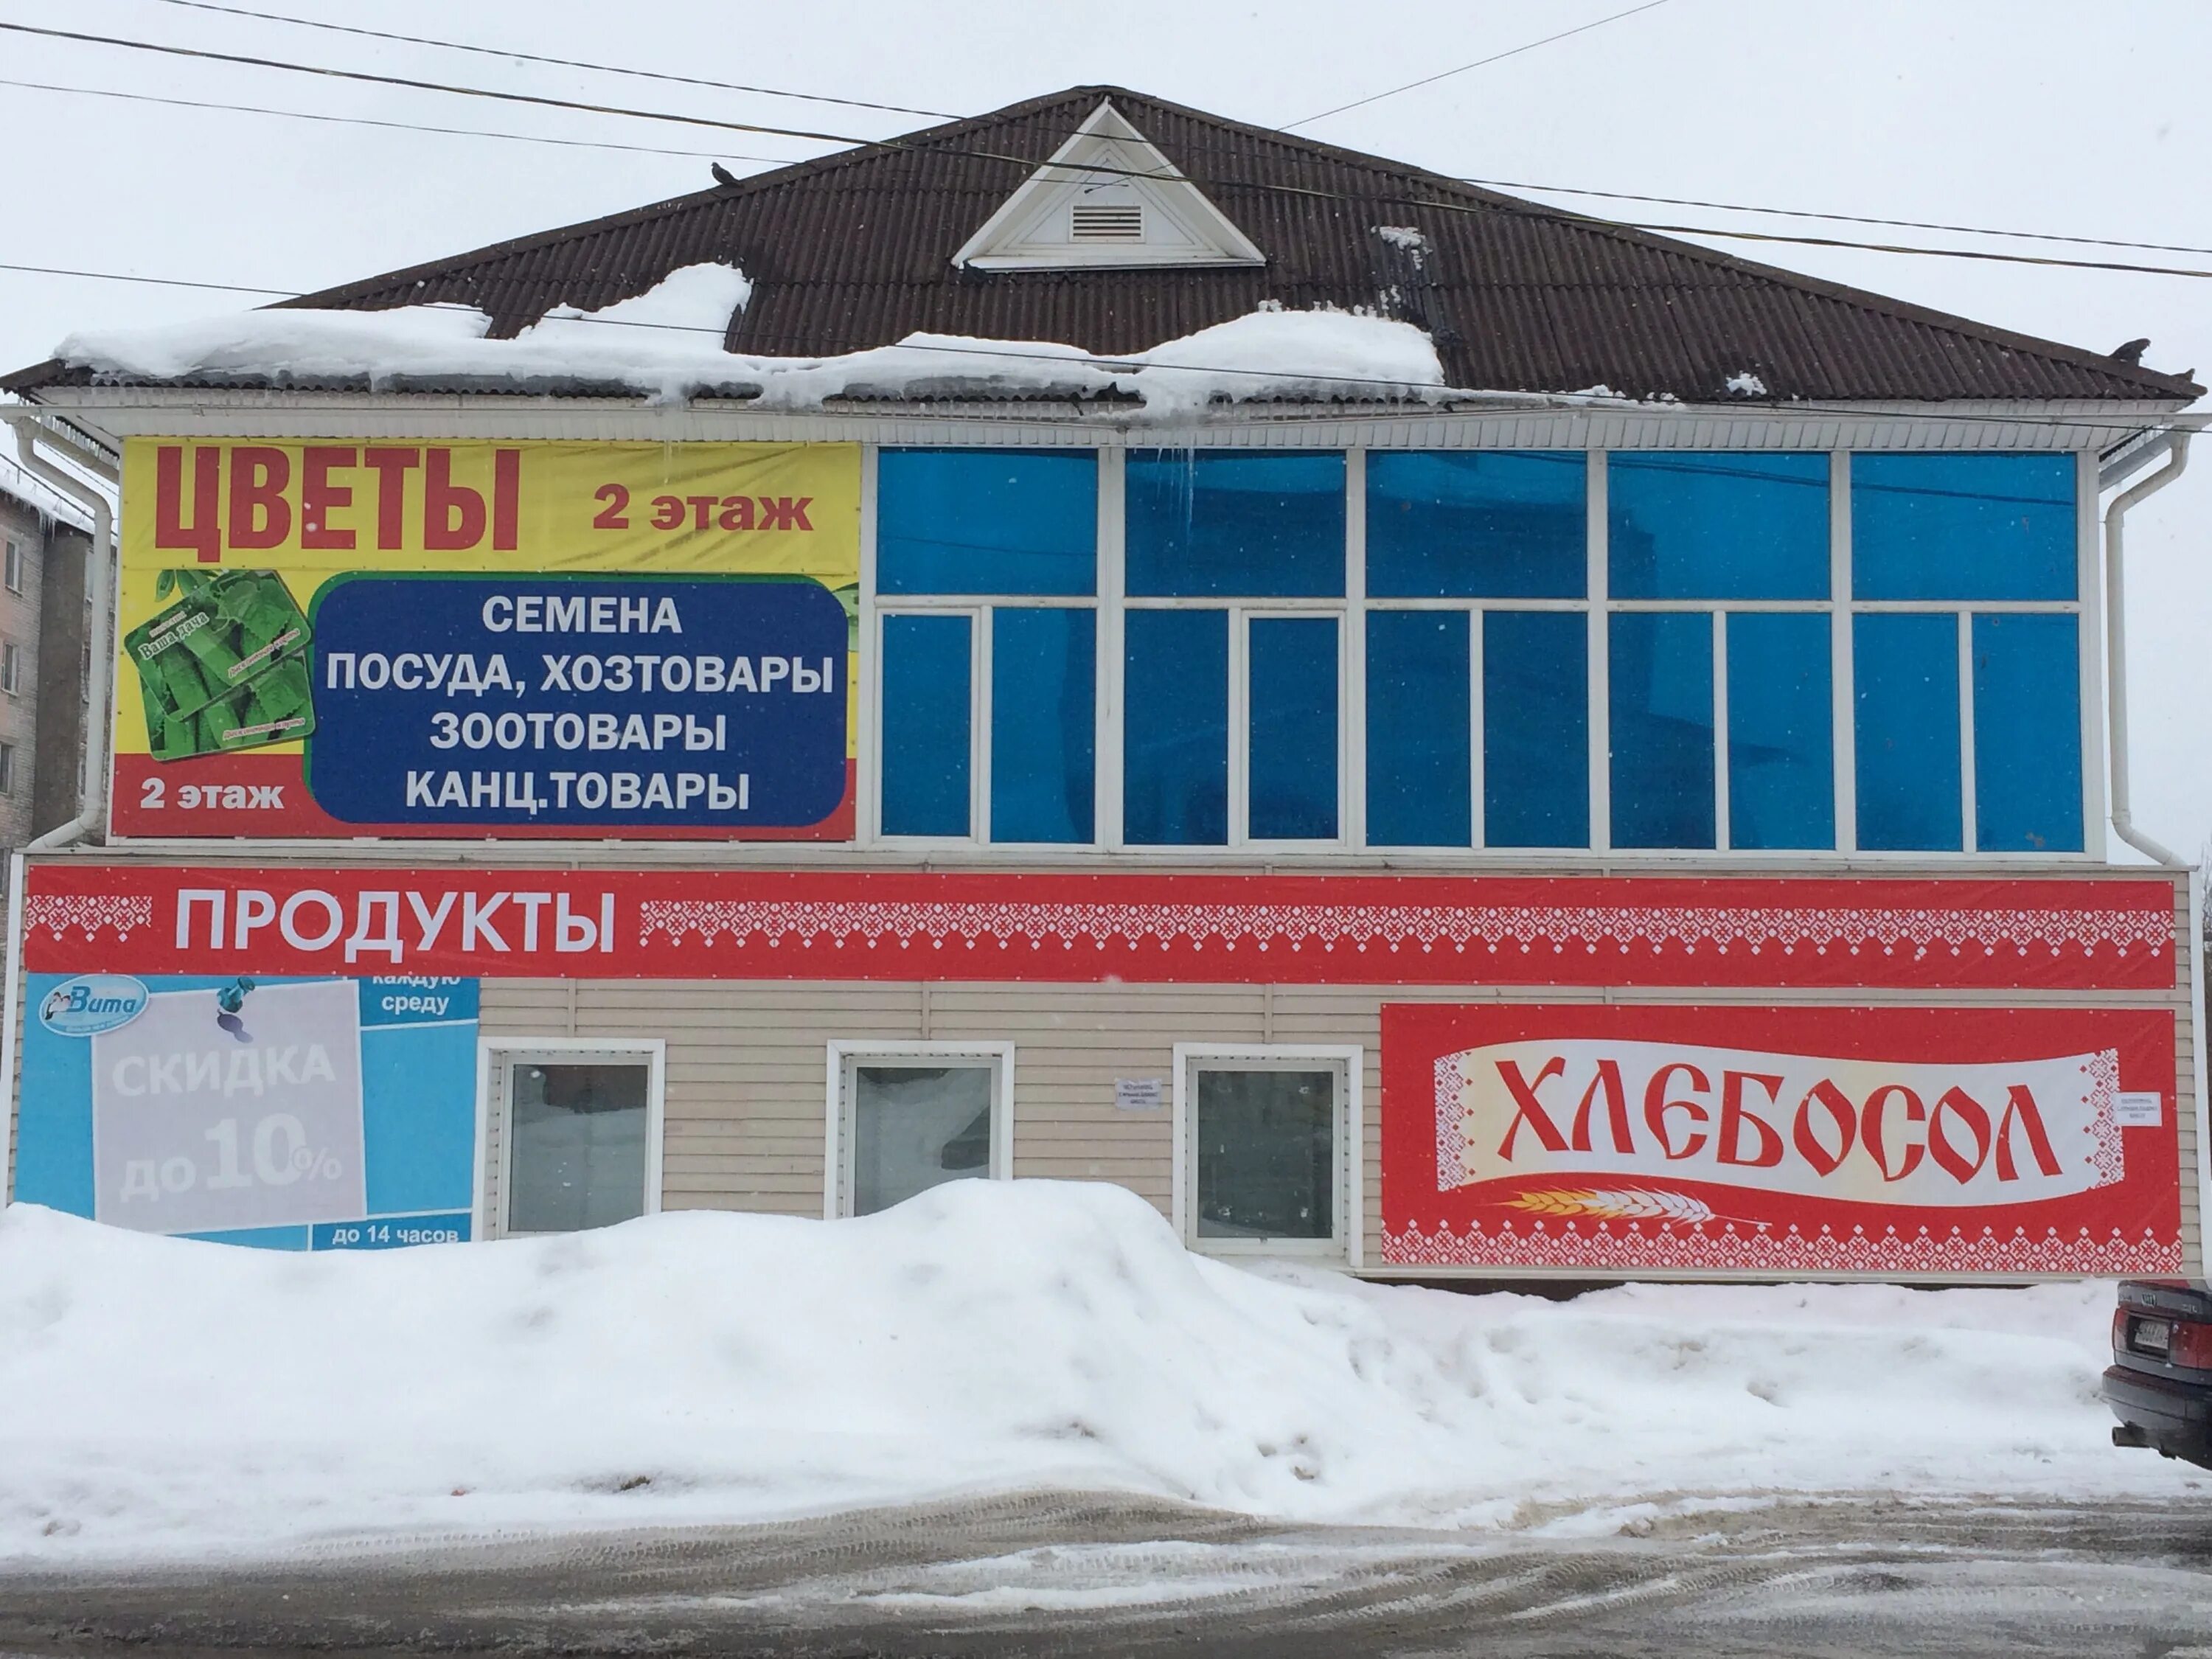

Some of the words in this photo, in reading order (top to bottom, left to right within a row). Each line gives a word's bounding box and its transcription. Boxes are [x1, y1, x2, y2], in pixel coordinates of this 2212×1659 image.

[155, 445, 521, 563] ЦВЕТЫ
[592, 483, 630, 529] 2
[650, 495, 815, 532] этаж
[139, 630, 177, 659] Ваша
[177, 612, 209, 640] дача
[481, 596, 683, 633] СЕМЕНА
[327, 653, 526, 699] ПОСУДА,
[540, 654, 833, 693] ХОЗТОВАРЫ
[429, 712, 726, 751] ЗООТОВАРЫ
[140, 778, 165, 809] 2
[178, 784, 285, 810] этаж
[406, 771, 750, 815] КАНЦ.ТОВАРЫ
[175, 888, 615, 964] ПРОДУКТЫ
[66, 986, 136, 1012] Вита
[381, 995, 450, 1015] среду
[112, 1043, 336, 1097] СКИДКА
[1494, 1057, 2064, 1185] ХЛЕБОСОЛ
[119, 1156, 197, 1203] до
[204, 1113, 342, 1190] 10%
[332, 1228, 360, 1245] до
[366, 1225, 390, 1242] 14
[397, 1229, 459, 1243] часов
